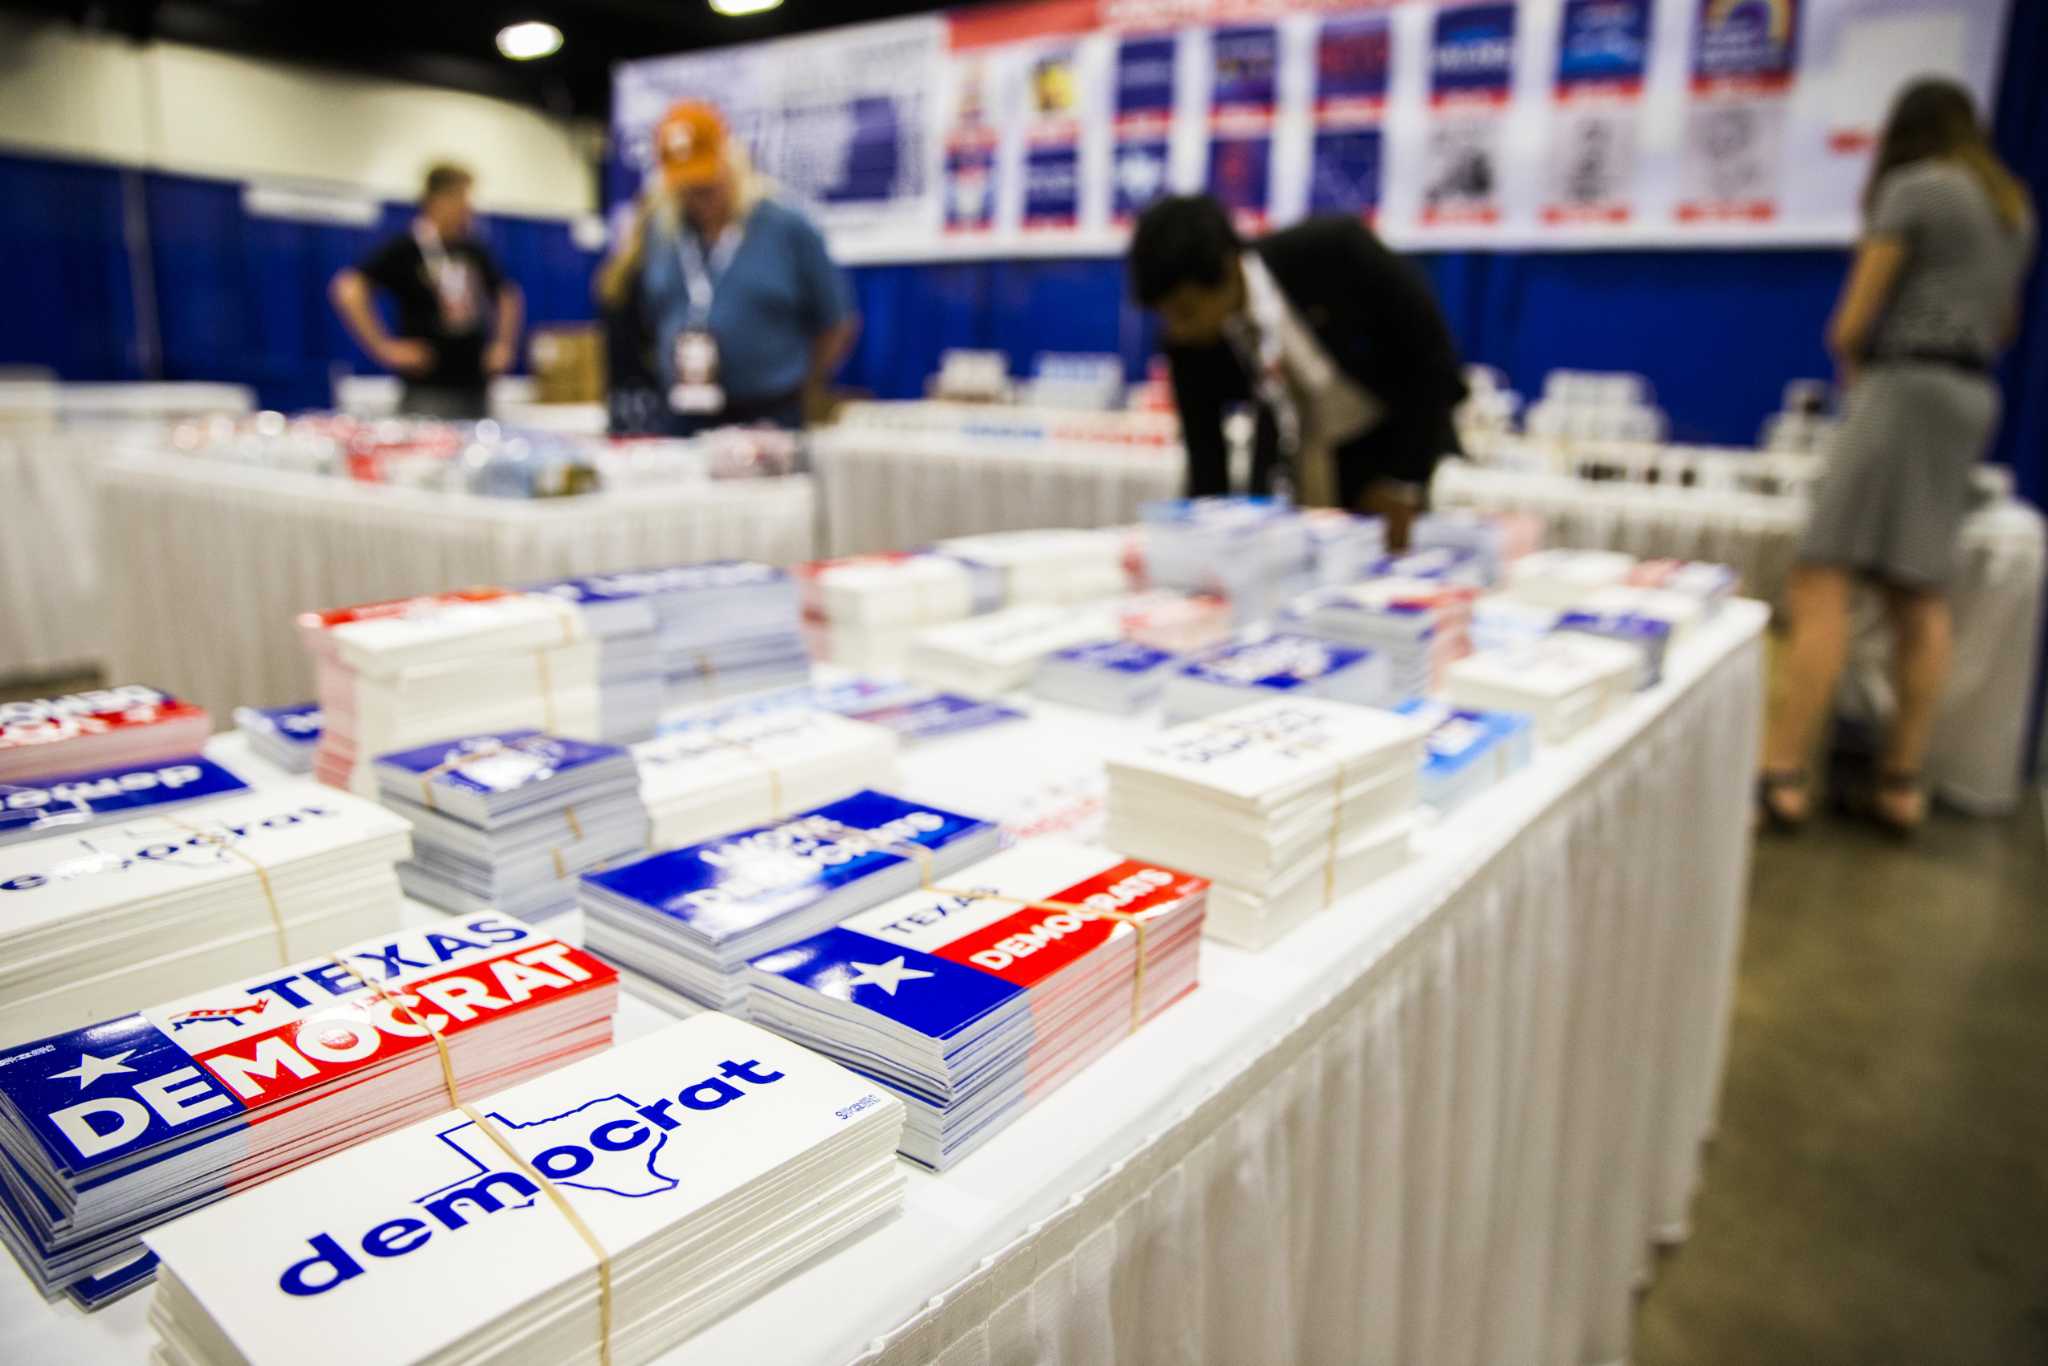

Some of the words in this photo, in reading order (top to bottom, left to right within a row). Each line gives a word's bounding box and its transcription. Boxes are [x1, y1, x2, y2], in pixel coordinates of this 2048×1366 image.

[245, 918, 529, 1010] TEXAS
[967, 868, 1174, 960] DEMOCRATS
[48, 943, 592, 1159] DEMOCRAT
[279, 1058, 786, 1297] democrat
